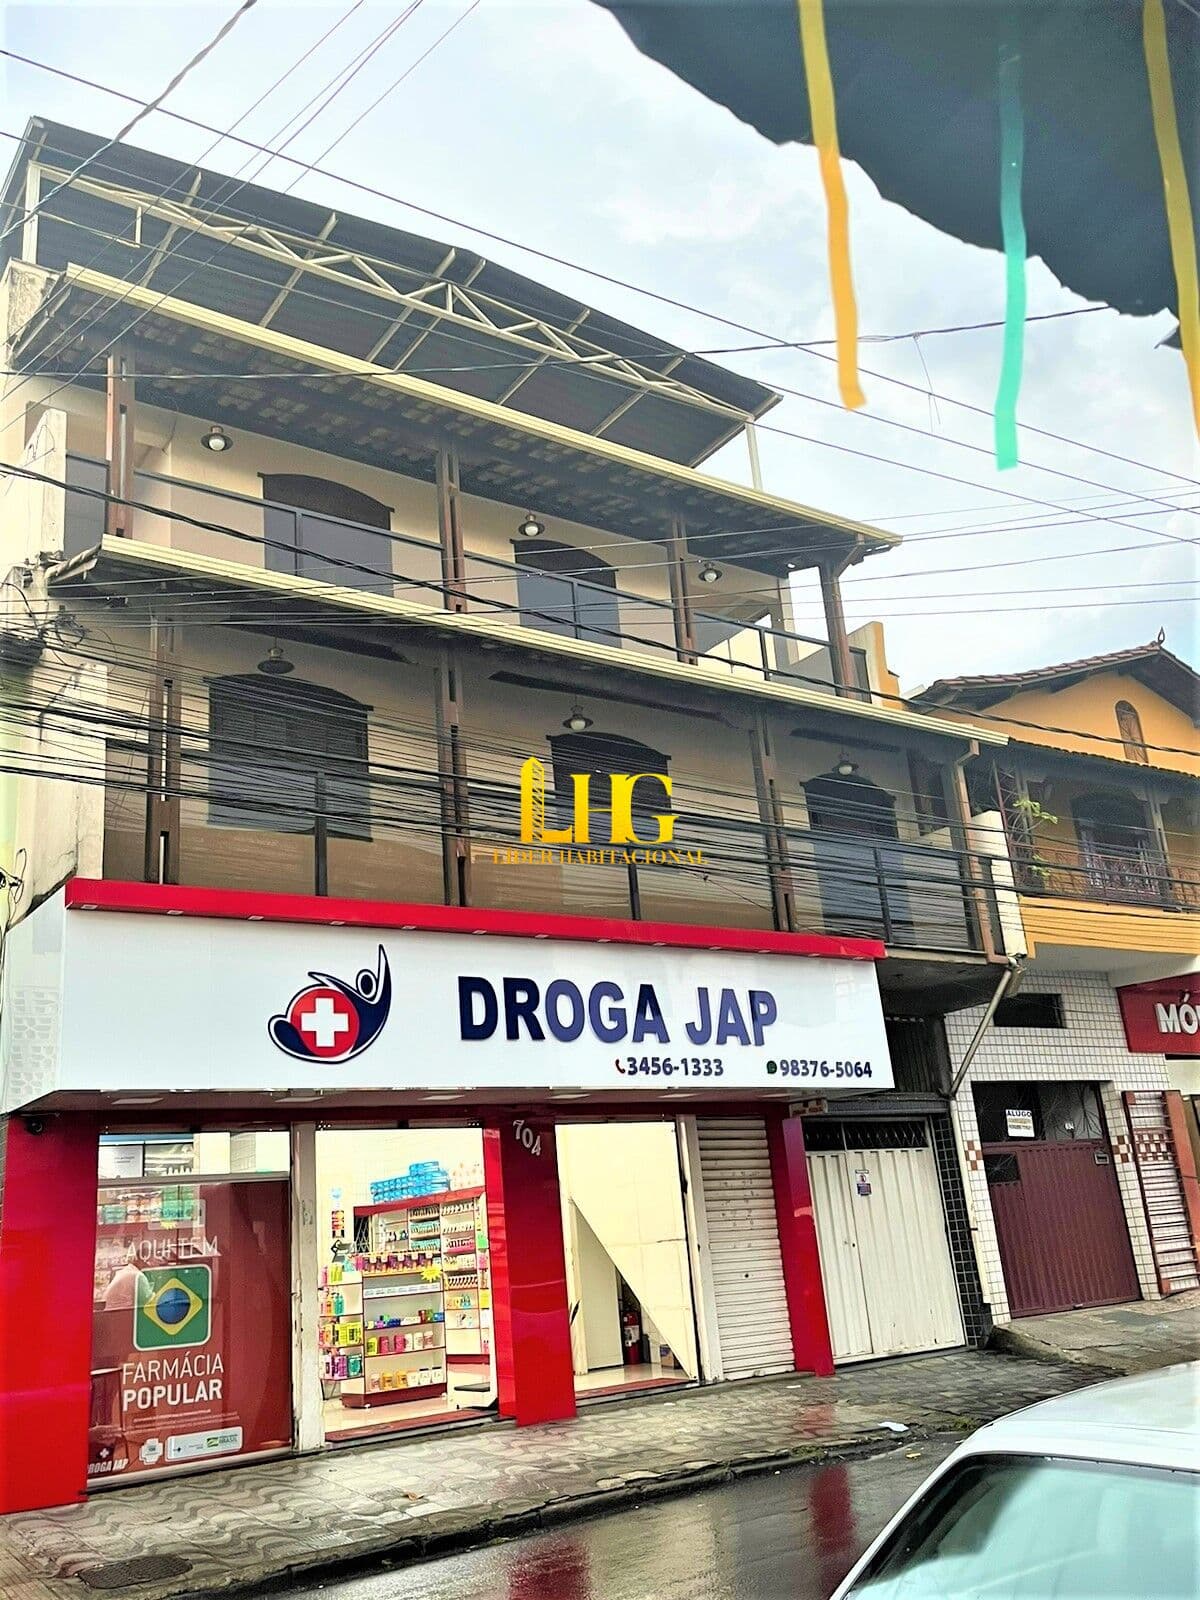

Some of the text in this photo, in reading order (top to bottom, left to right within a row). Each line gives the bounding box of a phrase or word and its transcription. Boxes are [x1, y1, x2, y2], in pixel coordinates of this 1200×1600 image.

[458, 976, 777, 1046] DROGA JAP
[627, 1057, 724, 1076] 3456-1333
[780, 1059, 873, 1078] 98376-5064
[512, 1119, 541, 1156] 704
[126, 1235, 219, 1262] AQUI TEM
[122, 1351, 224, 1385] FARMÁCIA
[122, 1379, 223, 1411] POPULAR
[87, 1460, 112, 1473] ROGA
